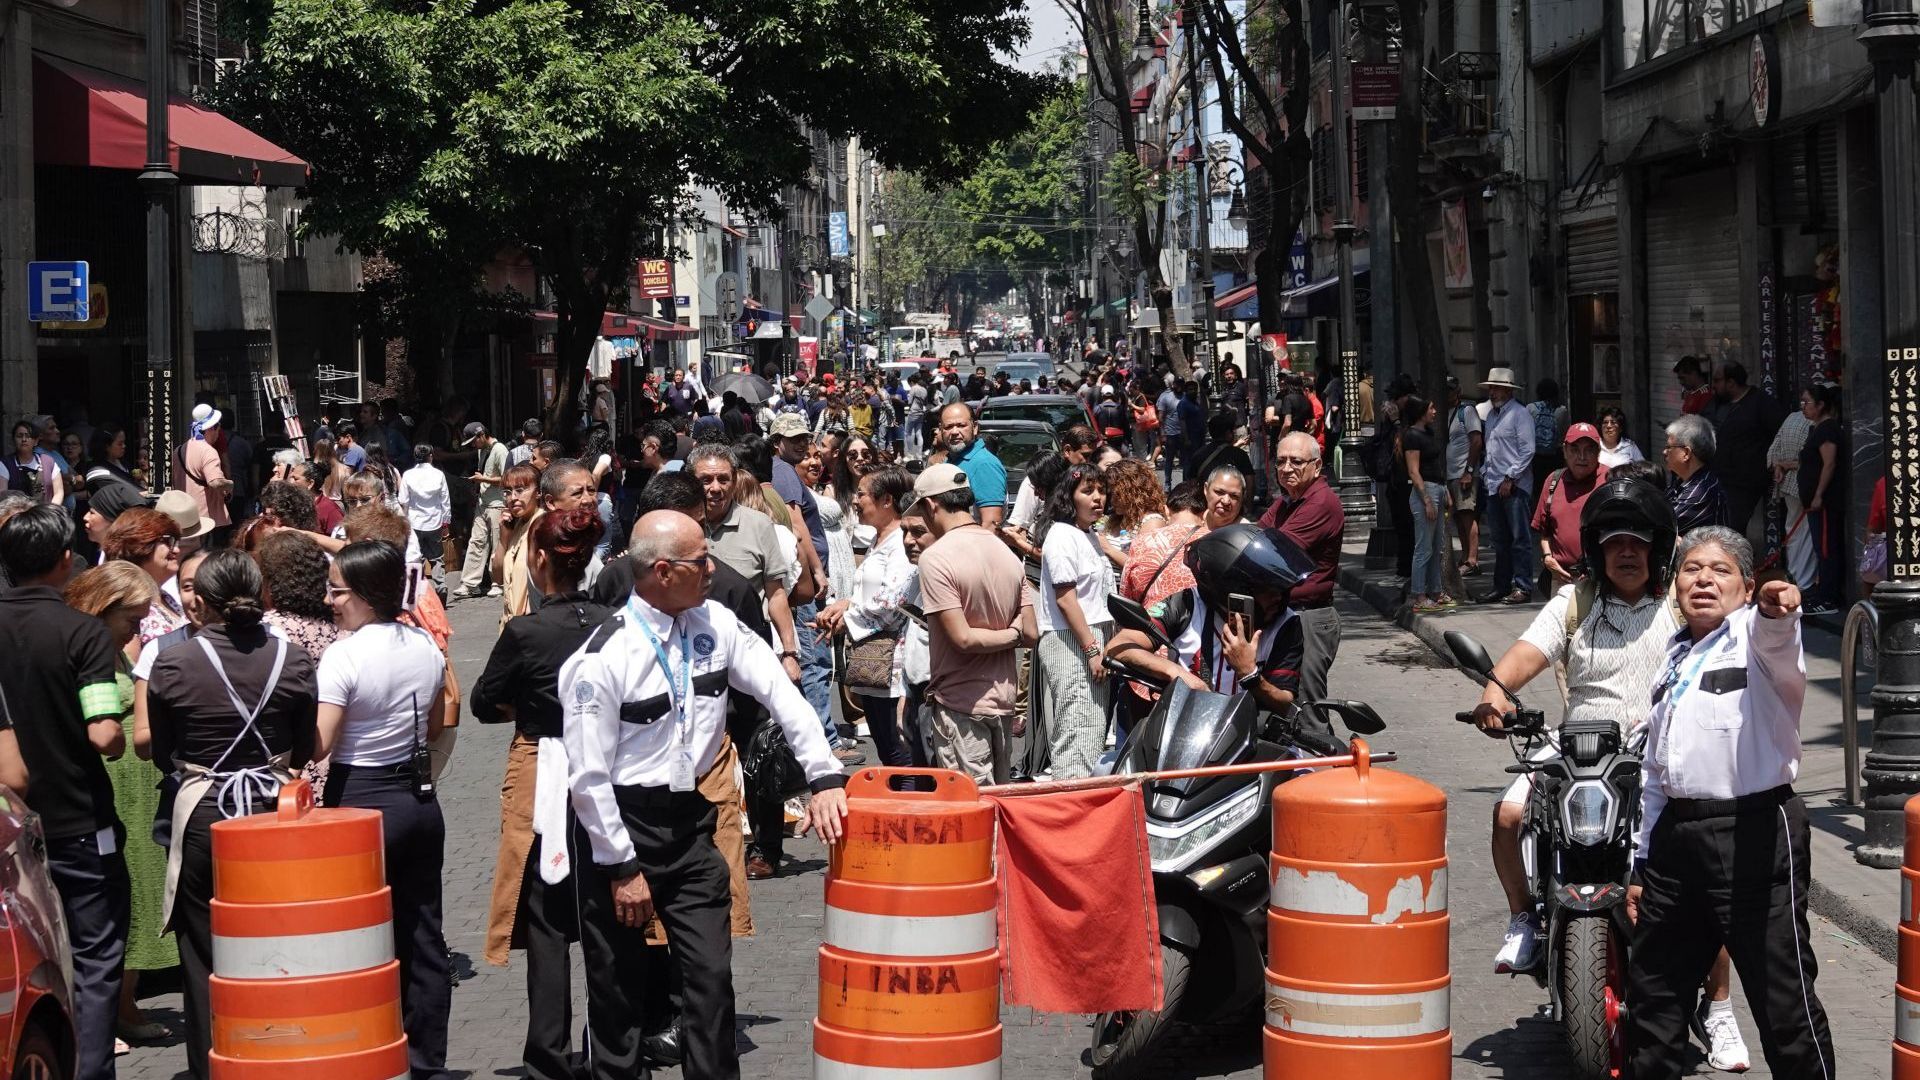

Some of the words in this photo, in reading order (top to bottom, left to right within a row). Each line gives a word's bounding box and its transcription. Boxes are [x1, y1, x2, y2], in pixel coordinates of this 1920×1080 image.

[643, 262, 666, 274] WC
[643, 276, 668, 286] DONCELES
[42, 271, 76, 312] E
[1761, 275, 1774, 396] ARTESANIAS
[873, 815, 962, 844] INBA
[871, 965, 961, 994] INBA
